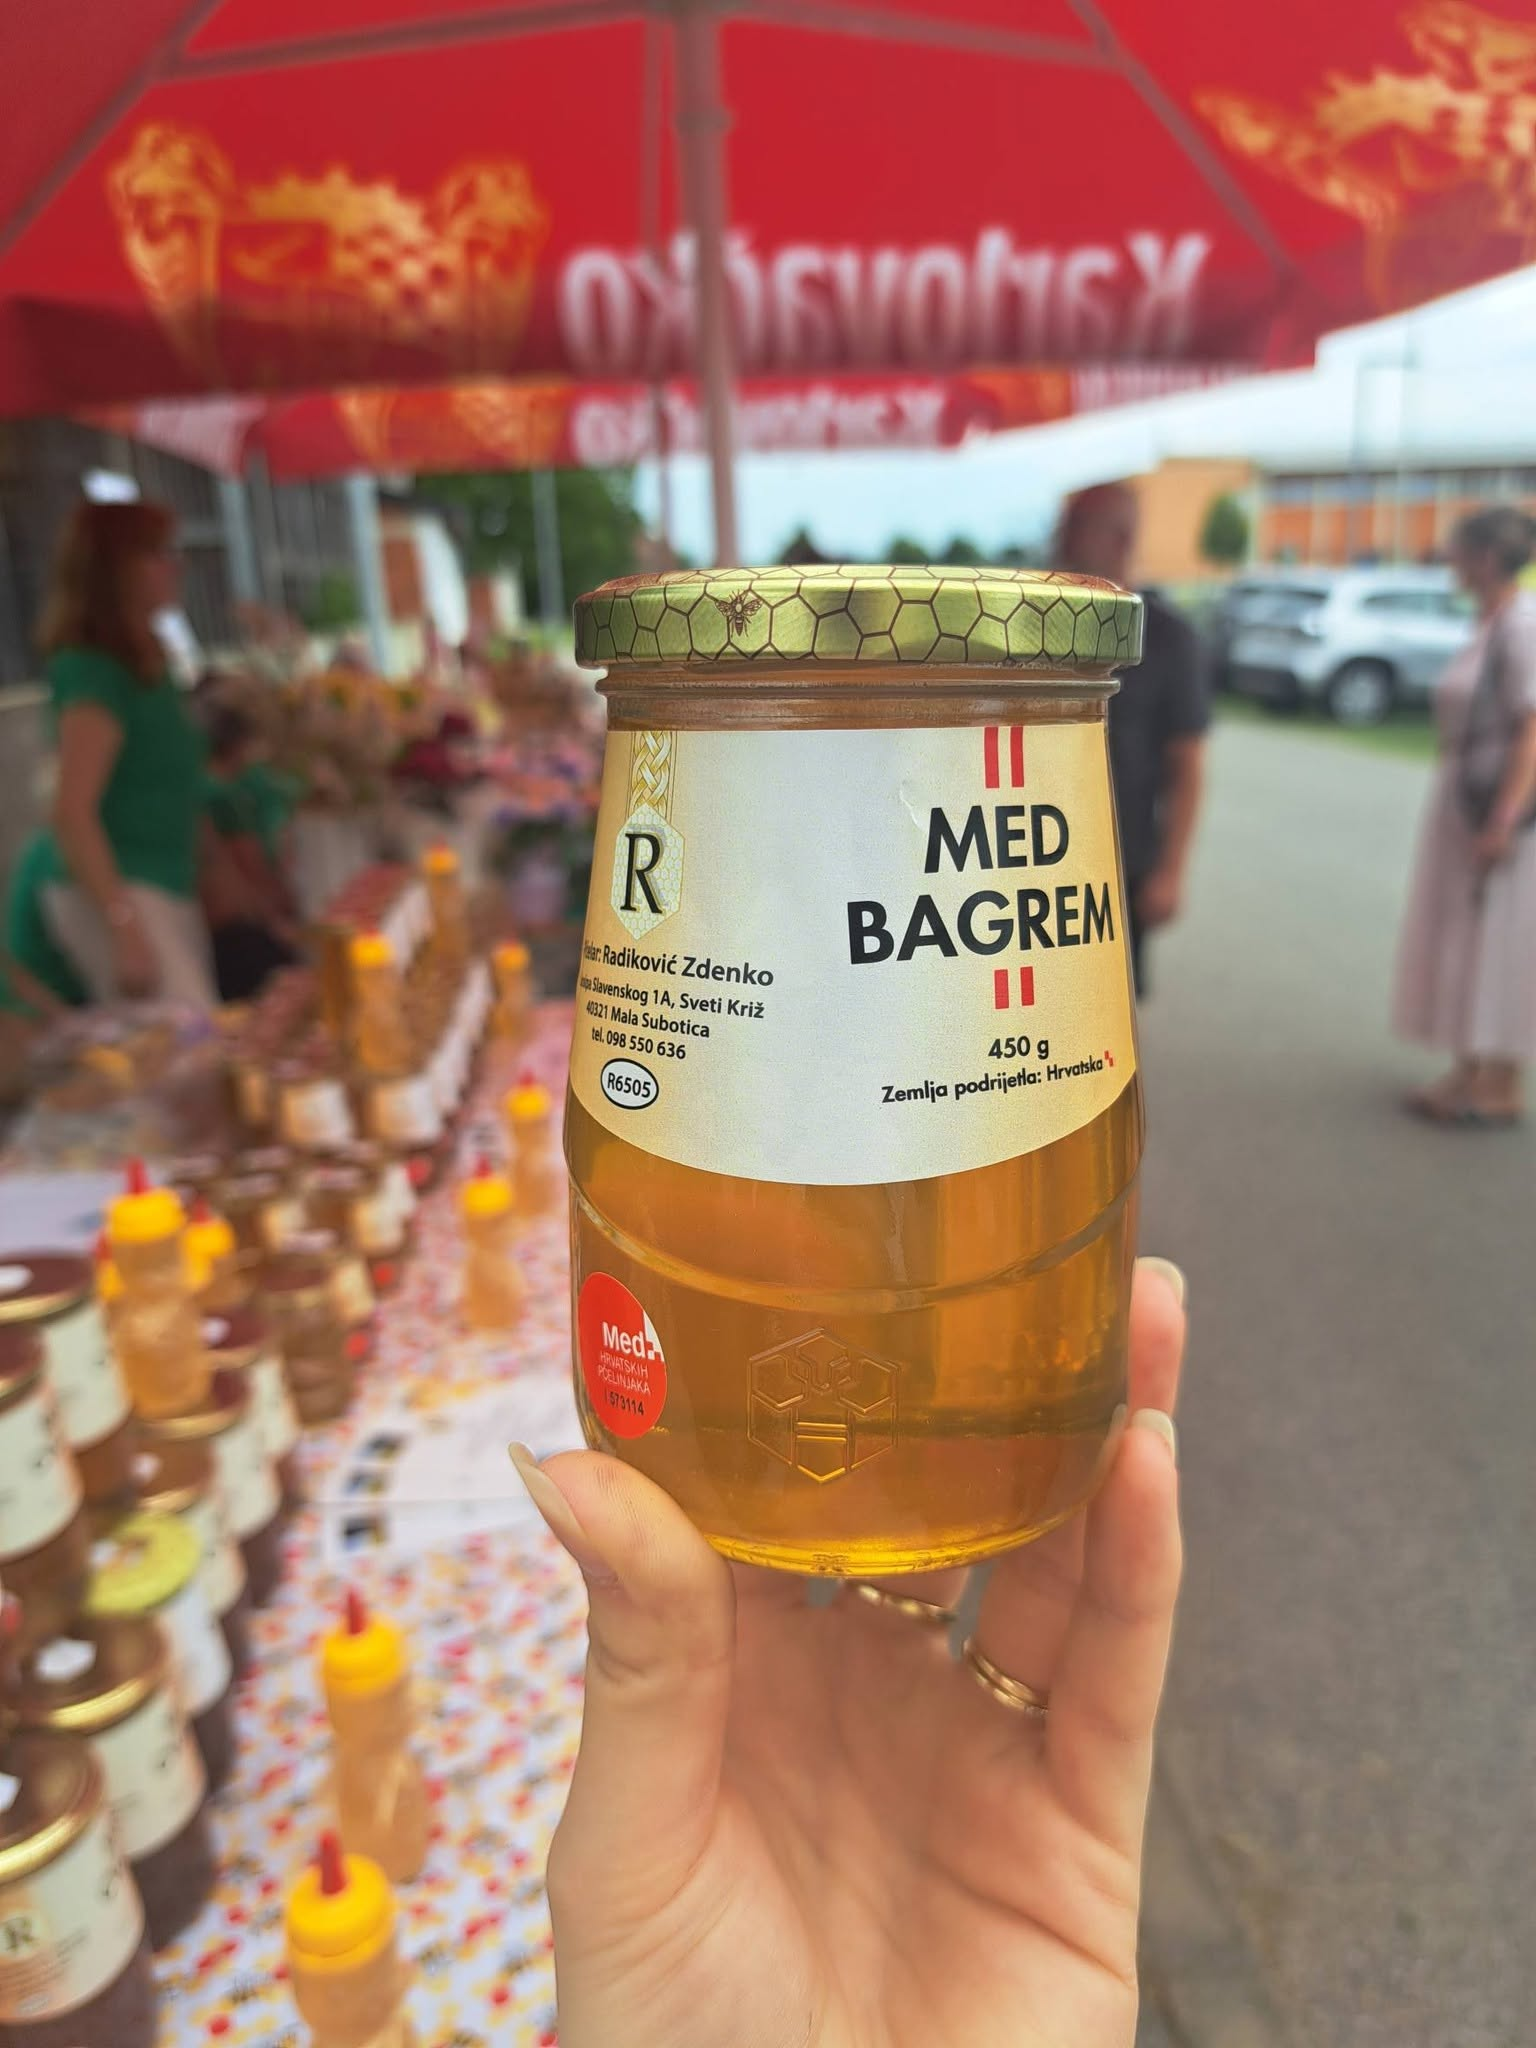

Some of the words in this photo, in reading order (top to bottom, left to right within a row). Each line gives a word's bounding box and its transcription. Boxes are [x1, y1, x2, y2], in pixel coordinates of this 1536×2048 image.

[924, 803, 1070, 874] MED
[619, 831, 663, 915] R
[847, 881, 1115, 965] BAGREM
[602, 944, 678, 975] Radiković
[681, 955, 774, 987] Zdenko
[592, 977, 649, 1006] Slavenskog
[653, 989, 675, 1010] 1A,
[679, 992, 722, 1014] Sveti
[727, 998, 765, 1019] Križ
[586, 999, 609, 1020] 40321
[610, 1006, 639, 1026] Mala
[641, 1012, 710, 1038] Subotica
[591, 1027, 605, 1043] tel.
[606, 1030, 627, 1048] 098
[629, 1035, 653, 1054] 550
[656, 1041, 686, 1060] 636
[988, 1035, 1031, 1059] 450
[1037, 1039, 1050, 1060] g
[607, 1071, 651, 1098] R6505
[881, 1080, 949, 1103] Zemlja
[954, 1067, 1042, 1101] podrijetla:
[1046, 1055, 1103, 1081] Hrvatska
[600, 1350, 649, 1380] HRVATSKIH
[609, 1391, 645, 1416] 573114
